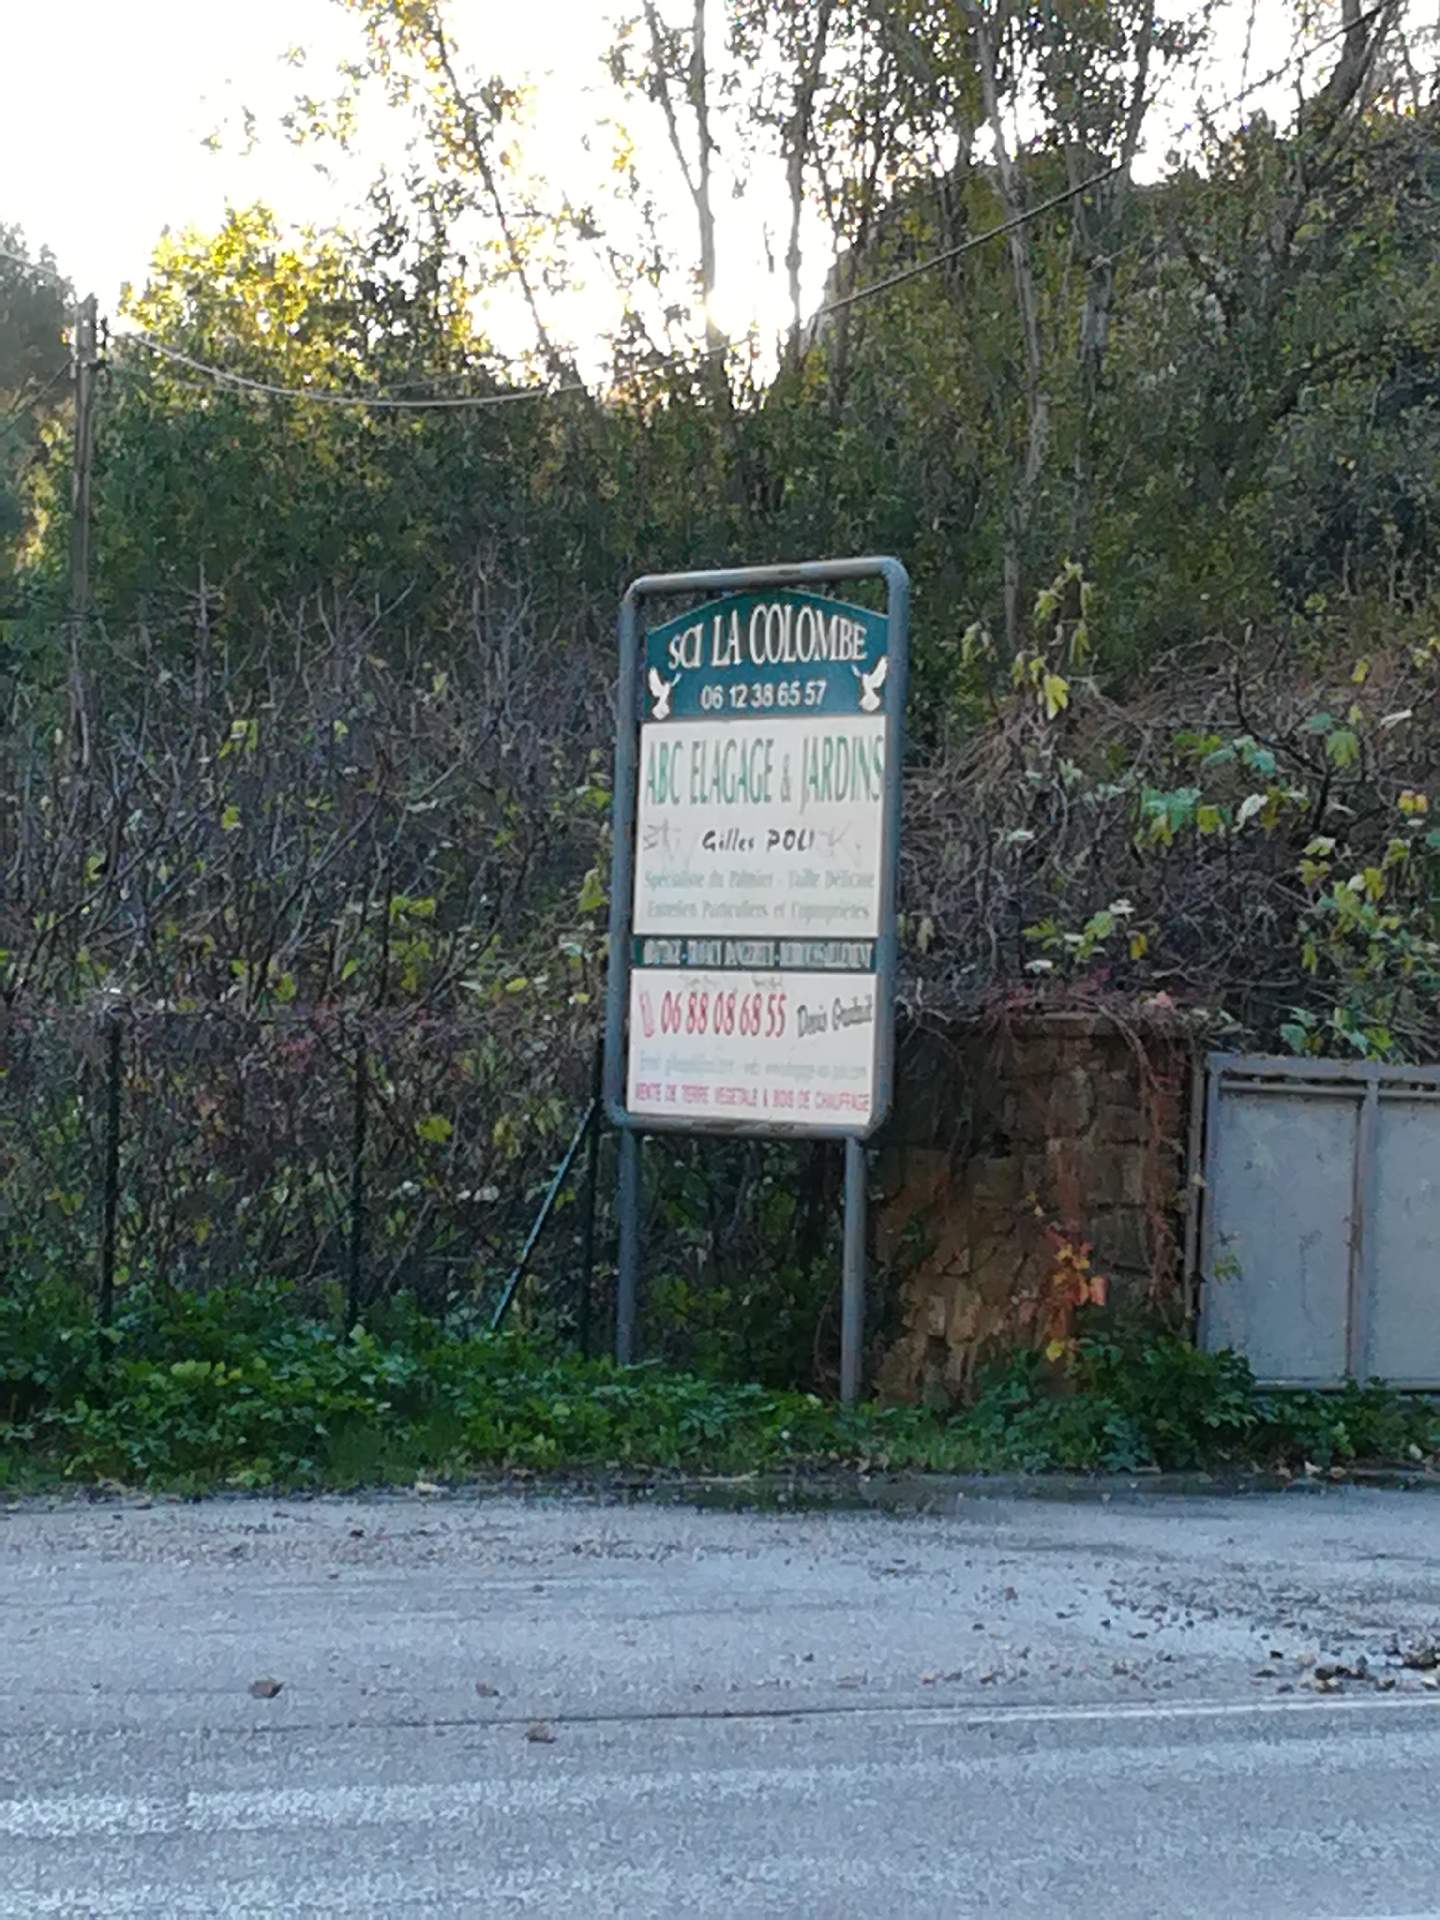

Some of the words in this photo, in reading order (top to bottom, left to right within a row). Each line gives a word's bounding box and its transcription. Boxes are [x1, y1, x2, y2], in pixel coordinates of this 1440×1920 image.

[668, 622, 704, 670] SCI
[712, 609, 743, 667] LA
[750, 603, 868, 665] COLOMBE
[701, 685, 724, 710] 06
[729, 684, 748, 708] 12
[751, 682, 774, 708] 38
[777, 681, 801, 707] 65
[804, 679, 827, 706] 57
[646, 740, 684, 805] ABC
[689, 737, 774, 804] ELAGAGE
[800, 735, 884, 814] JARDINS
[701, 828, 755, 852] Gilles
[660, 990, 682, 1035] 06
[686, 991, 708, 1035] 88
[713, 991, 737, 1036] 08
[739, 992, 762, 1037] 68
[765, 993, 788, 1038] 55
